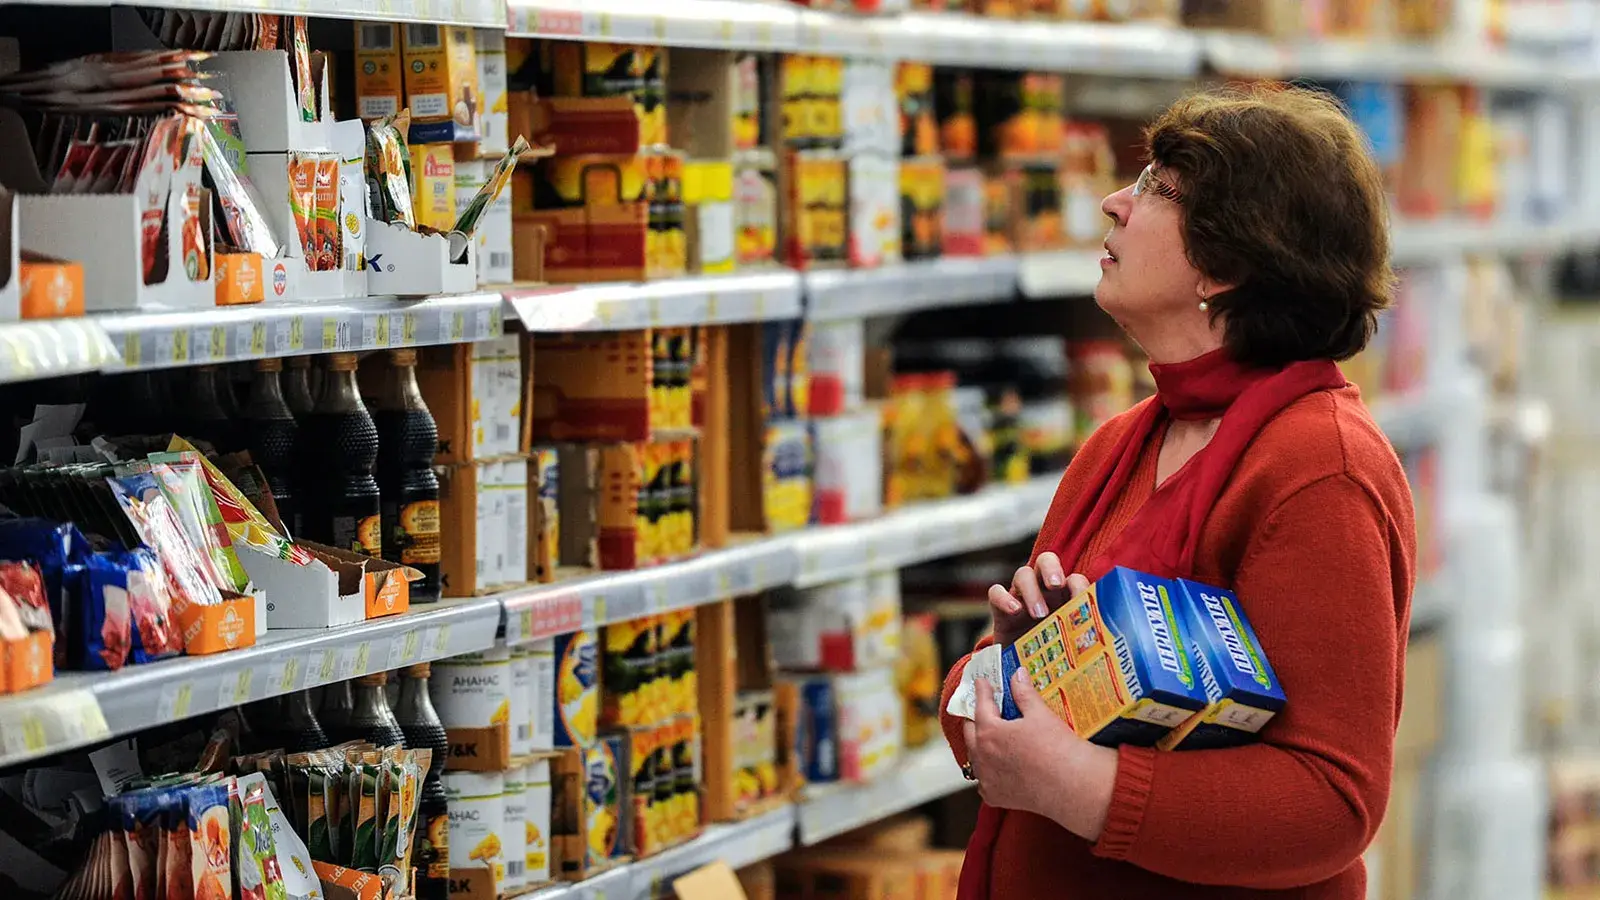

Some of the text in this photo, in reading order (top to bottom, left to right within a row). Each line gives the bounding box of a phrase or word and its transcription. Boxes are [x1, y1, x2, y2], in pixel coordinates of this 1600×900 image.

[1137, 581, 1180, 673] ГЕРКУЛЕС
[1200, 593, 1255, 674] ГЕРКУЛЕС
[453, 674, 500, 686] АНАНАС
